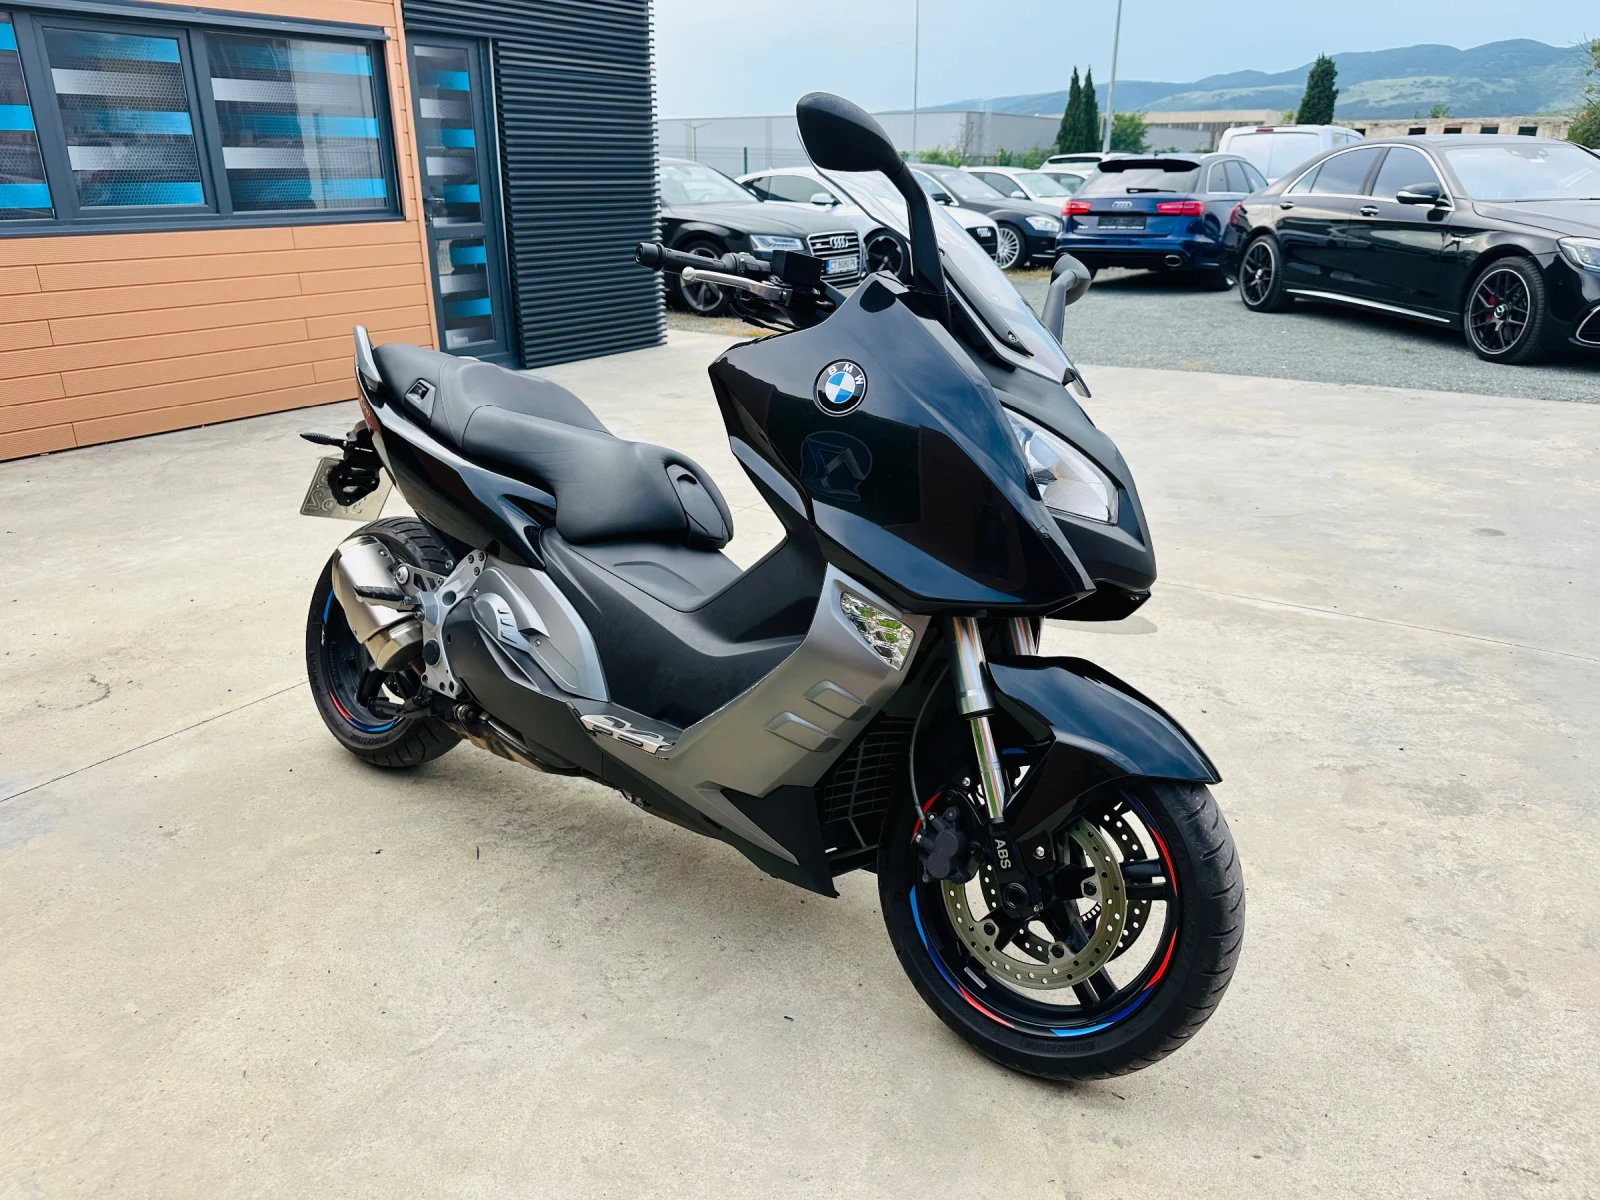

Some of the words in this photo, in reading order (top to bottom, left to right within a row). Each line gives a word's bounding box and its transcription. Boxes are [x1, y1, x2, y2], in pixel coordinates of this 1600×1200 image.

[827, 363, 864, 384] BMW
[995, 839, 1011, 869] ABS
[1022, 1040, 1095, 1053] BRIDGESTONE
